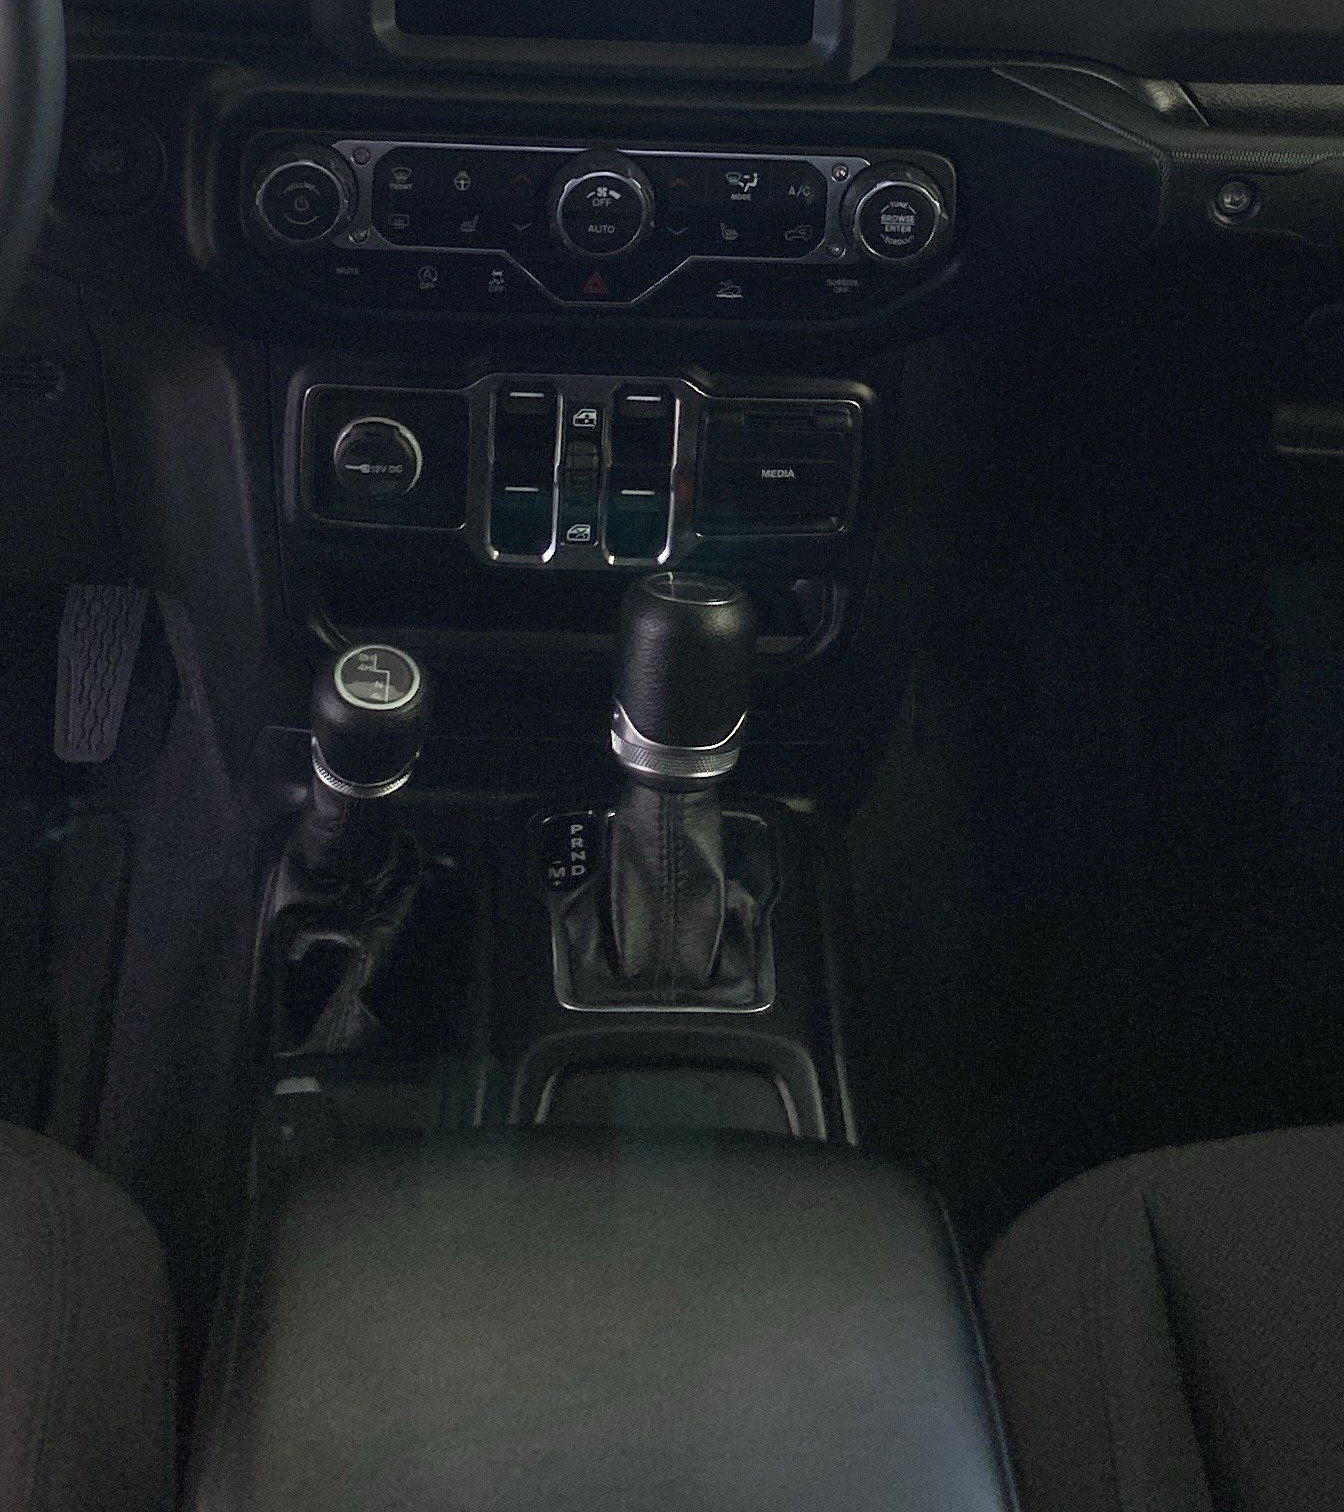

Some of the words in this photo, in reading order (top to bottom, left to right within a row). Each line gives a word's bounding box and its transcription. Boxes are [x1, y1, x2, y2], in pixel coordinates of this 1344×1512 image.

[788, 184, 812, 197] A/C
[592, 198, 612, 207] OFF
[880, 215, 915, 225] BROWSE
[587, 224, 616, 234] AUTO
[884, 225, 912, 234] ENTER
[761, 468, 796, 479] MEDIA
[548, 866, 567, 879] M
